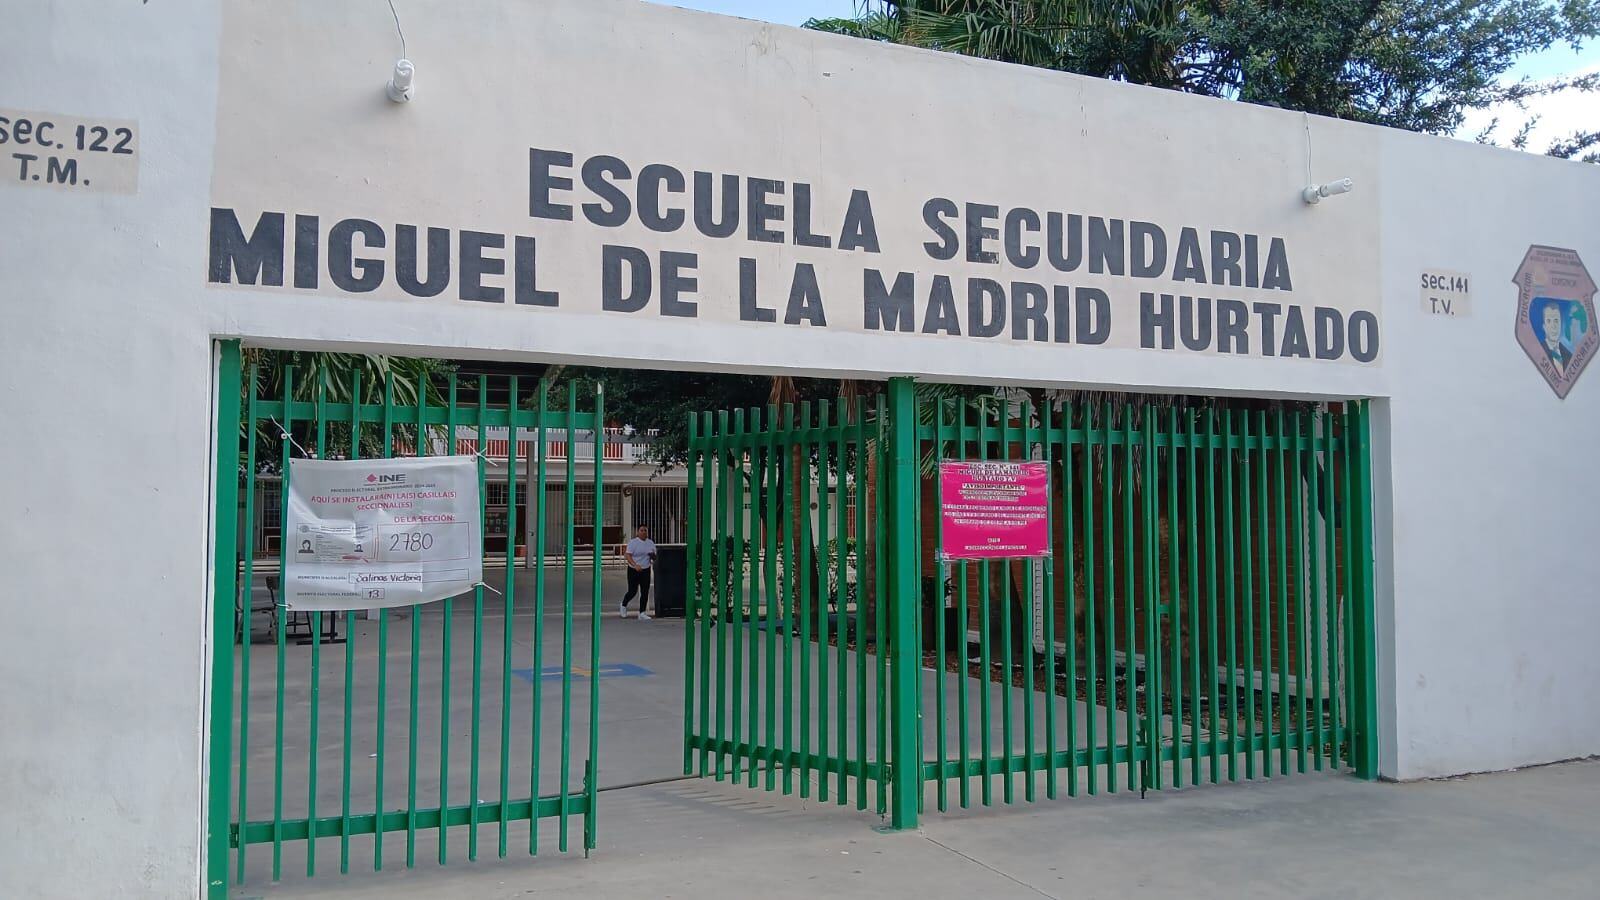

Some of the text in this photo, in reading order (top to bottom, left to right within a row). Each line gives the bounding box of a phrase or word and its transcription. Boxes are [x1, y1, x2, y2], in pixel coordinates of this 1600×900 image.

[75, 125, 134, 155] 122
[12, 152, 90, 187] T.M.
[530, 147, 1293, 292] ESCUELA SECUNDARIA
[208, 207, 1379, 363] MIGUEL DE LA MADRID HURTADO
[1429, 297, 1455, 315] T.V.
[379, 473, 406, 483] INE
[396, 491, 416, 501] LA(S)
[417, 491, 457, 501] CASILLA(S)
[356, 502, 413, 512] SECCIONAL(ES)
[419, 514, 455, 523] SECCIÓN:
[388, 532, 434, 552] 2780
[355, 572, 422, 584] Salinas Victoria
[368, 590, 380, 599] 13
